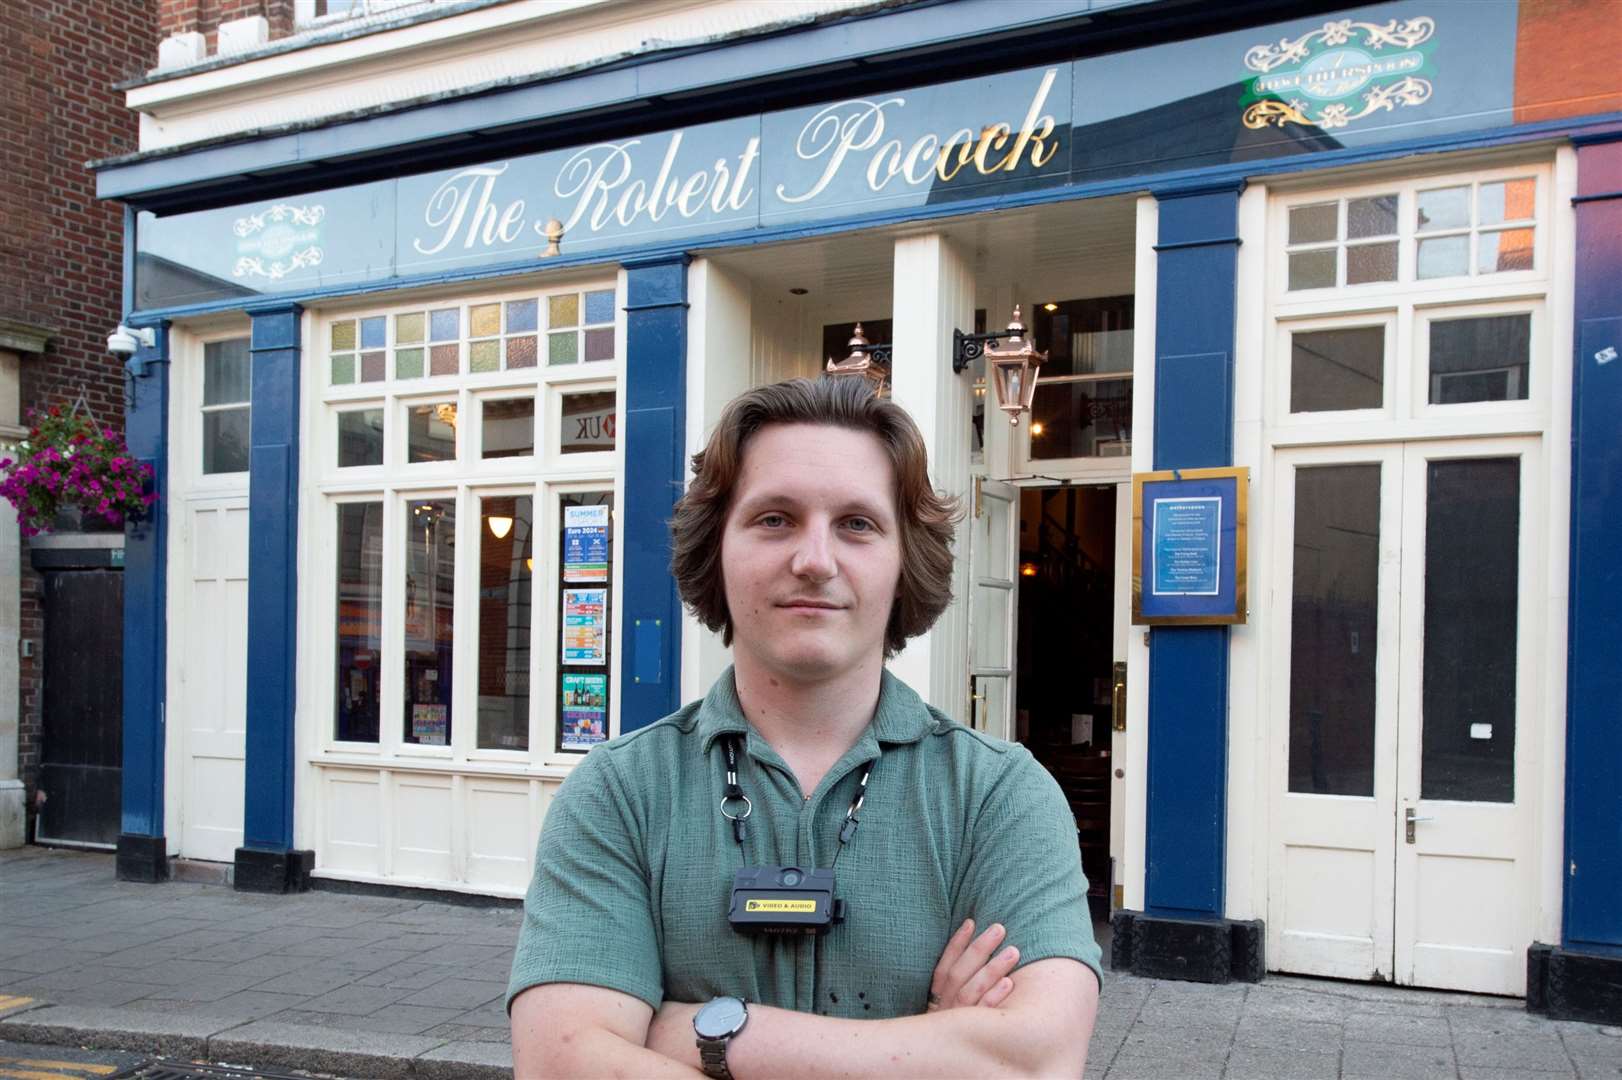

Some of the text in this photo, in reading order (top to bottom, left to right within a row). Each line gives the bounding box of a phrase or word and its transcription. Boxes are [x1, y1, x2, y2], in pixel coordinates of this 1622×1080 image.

[414, 68, 1058, 254] The Robert Pocock
